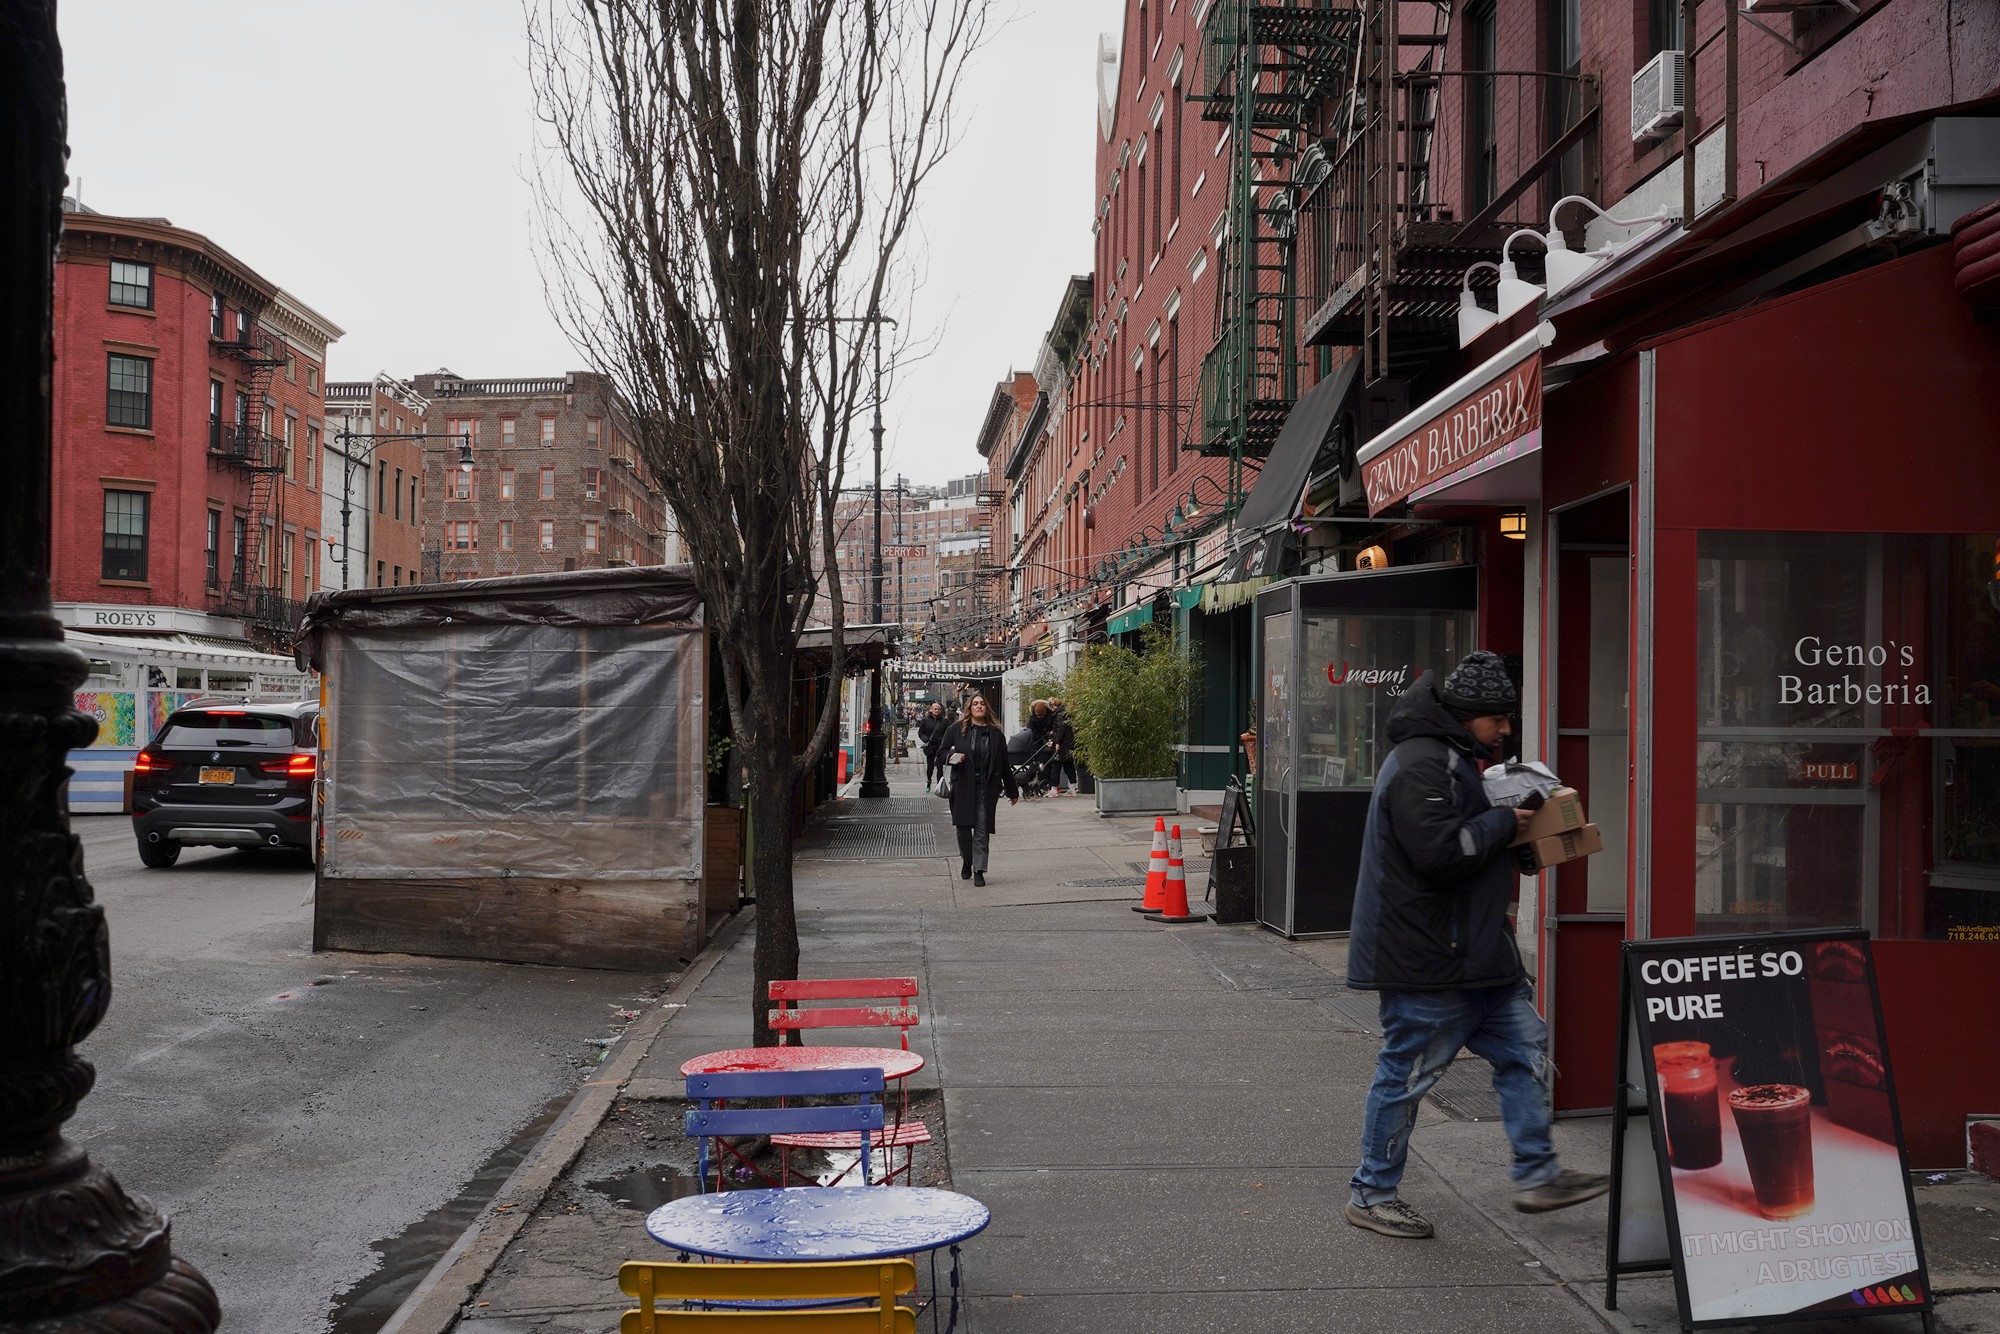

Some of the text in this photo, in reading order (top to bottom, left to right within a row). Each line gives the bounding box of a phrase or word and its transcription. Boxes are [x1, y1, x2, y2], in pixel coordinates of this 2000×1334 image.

[1367, 373, 1529, 507] GENO'S BARBERIA
[883, 546, 926, 557] PERRY ST
[95, 610, 156, 626] ROEY'S
[1327, 660, 1406, 686] Umami
[1777, 673, 1932, 706] Barberia
[1806, 764, 1854, 779] PULL
[1641, 950, 1803, 985] COFFEE SO
[1646, 993, 1724, 1022] PURE
[1683, 1217, 1913, 1257] IT MIGHT SHOW ON
[1756, 1251, 1918, 1285] A DRUG TEST
